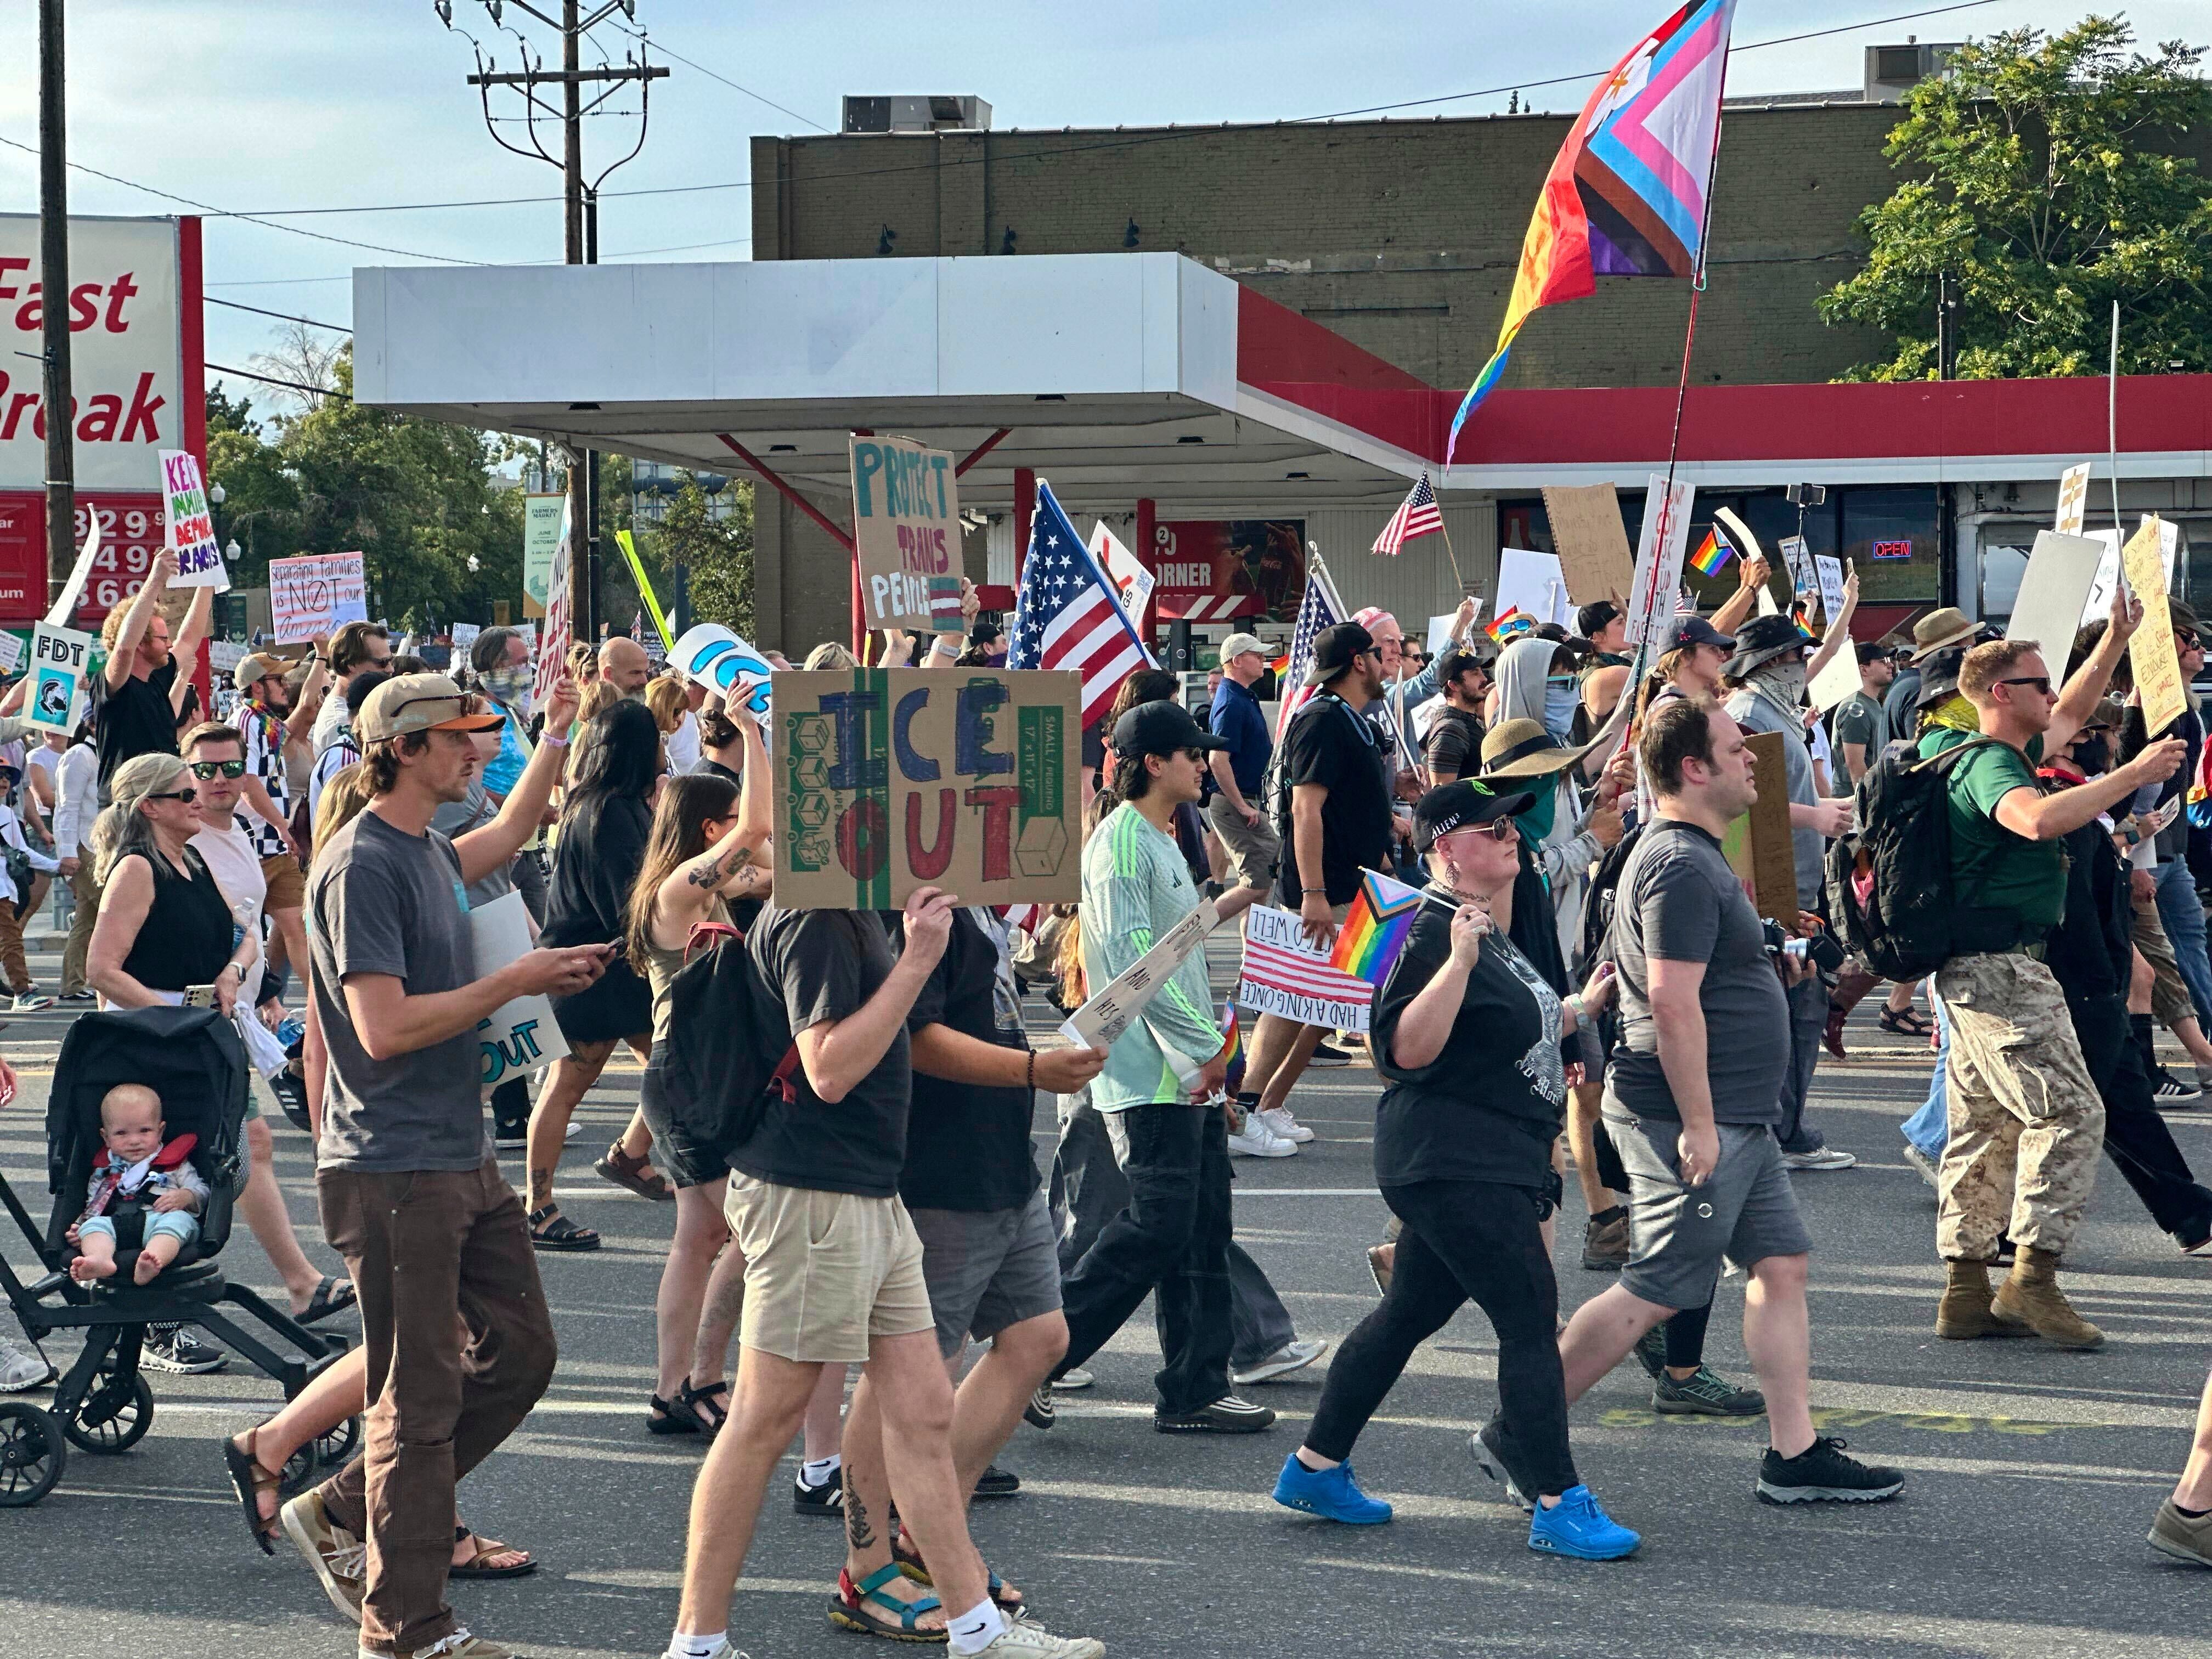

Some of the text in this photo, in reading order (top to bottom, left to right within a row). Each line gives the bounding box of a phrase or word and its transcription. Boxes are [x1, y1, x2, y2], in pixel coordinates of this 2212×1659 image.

[855, 443, 949, 519] PROTECT
[1159, 530, 1166, 540] 2
[896, 524, 949, 574] TRANS
[1650, 537, 1674, 561] MSK
[1876, 543, 1909, 556] OPEN
[271, 555, 361, 589] separating families
[276, 594, 284, 608] is
[344, 588, 362, 601] our
[871, 571, 931, 619] PEOPLE
[279, 615, 357, 639] Americ
[37, 634, 84, 667] FDT
[819, 684, 1015, 790] ICE
[1045, 715, 1056, 755] SMALL
[835, 785, 1028, 882] OUT
[1252, 910, 1288, 942] WELL
[1124, 967, 1151, 991] AND
[1240, 982, 1276, 1008] ONCE
[1277, 992, 1313, 1020] KING
[1093, 997, 1120, 1021] HIS
[1317, 1001, 1326, 1023] A
[1330, 1003, 1357, 1029] HAD
